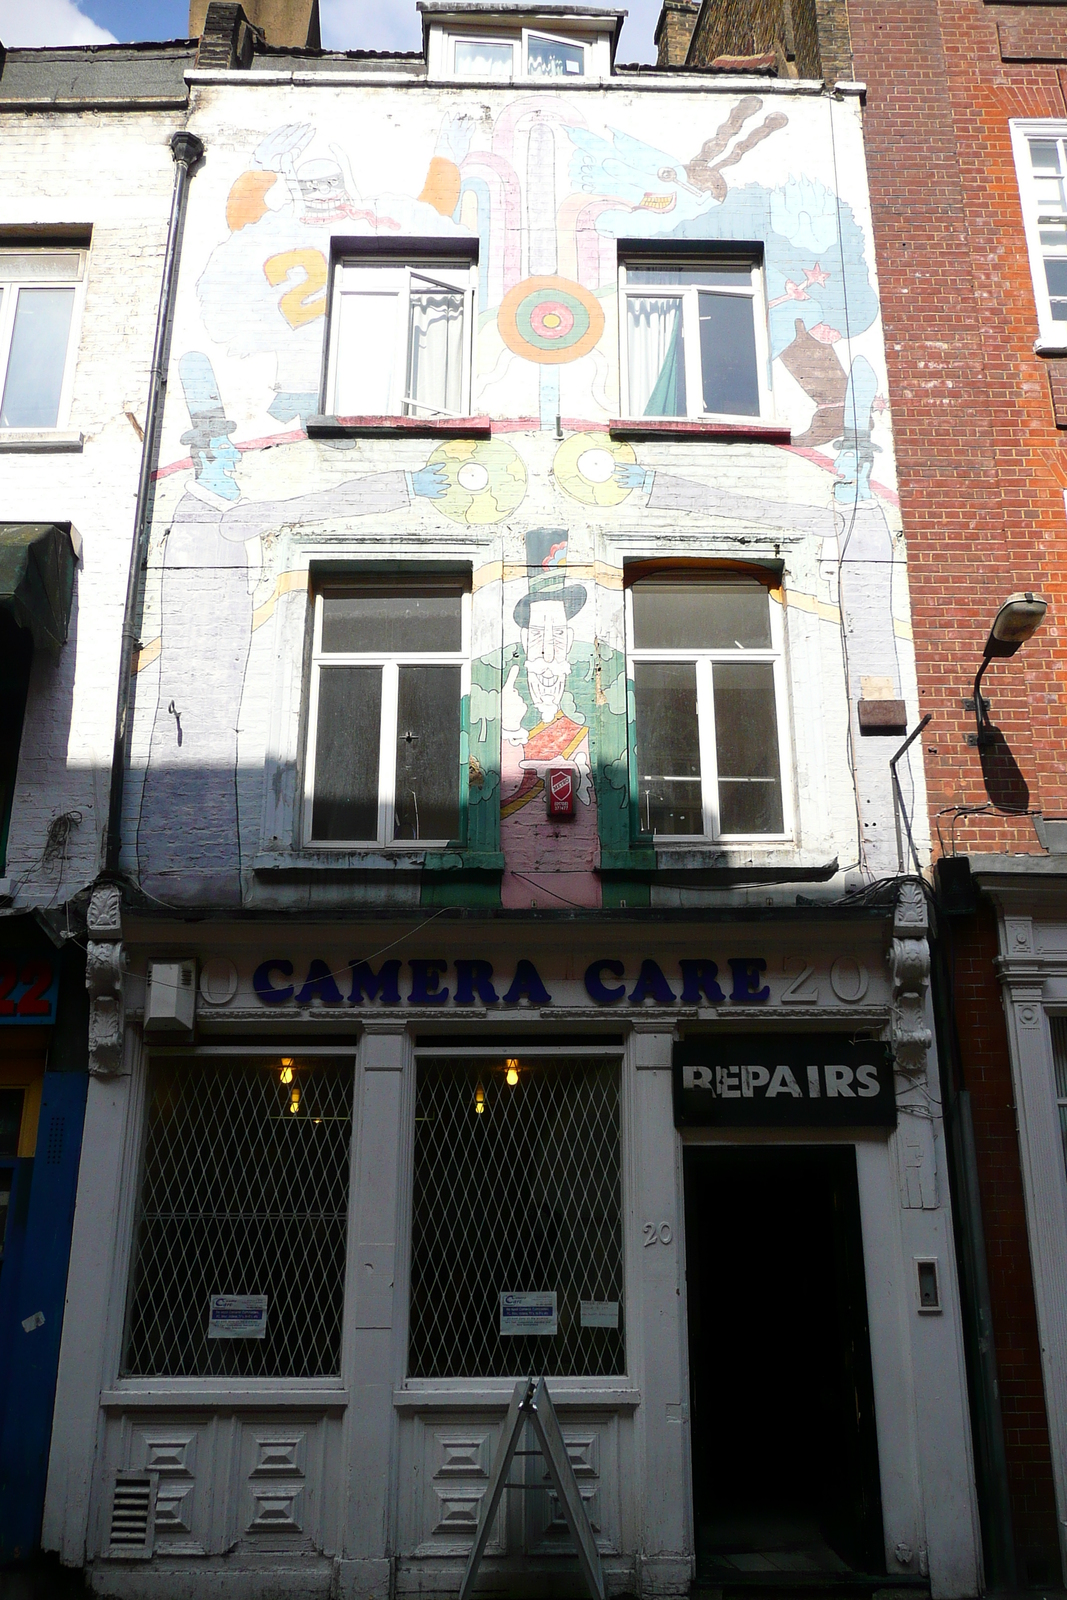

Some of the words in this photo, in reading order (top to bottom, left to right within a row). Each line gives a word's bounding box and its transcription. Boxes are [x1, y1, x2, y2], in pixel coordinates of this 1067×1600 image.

[553, 778, 570, 791] METRO
[253, 959, 552, 1003] CAMERA
[584, 957, 771, 1003] CARE
[781, 955, 870, 1005] 20
[682, 1064, 881, 1099] REPAIRS
[643, 1221, 673, 1248] 20
